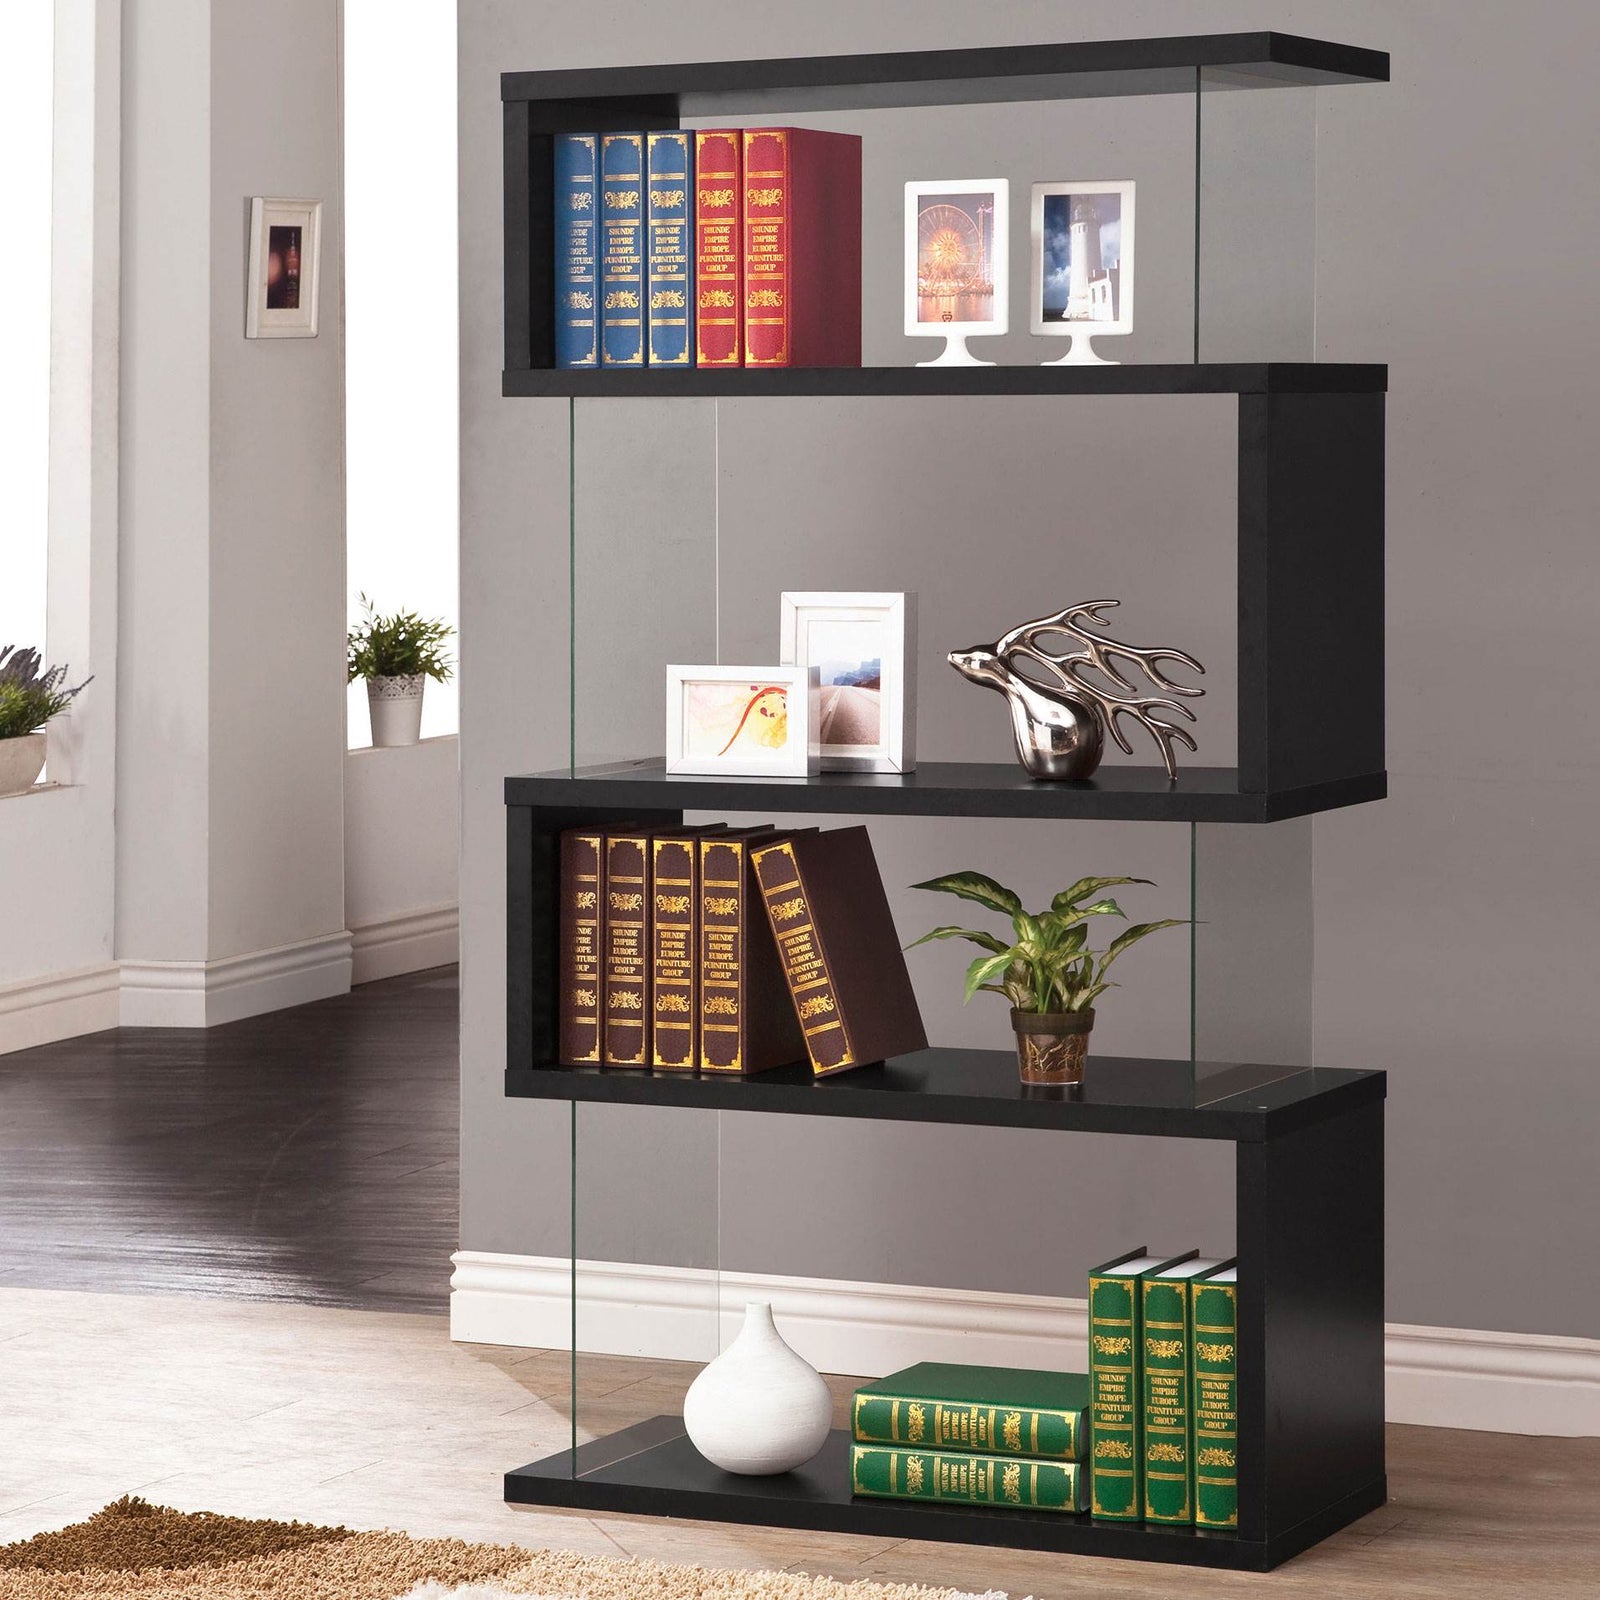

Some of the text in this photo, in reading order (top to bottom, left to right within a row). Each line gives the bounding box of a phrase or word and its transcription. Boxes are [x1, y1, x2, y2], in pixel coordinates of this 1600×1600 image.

[752, 225, 778, 233] SHUNDE
[650, 255, 685, 263] FURNITURE
[613, 929, 638, 937] SHUNDE
[660, 931, 686, 939] SHUNDE
[614, 938, 637, 946] EMPIRE
[784, 933, 810, 947] SHUNDE
[613, 947, 637, 955] EUROPE
[709, 943, 733, 951] EMPIRE
[787, 943, 812, 956] EMPIRE
[661, 950, 685, 958] EUROPE
[709, 952, 733, 960] EUROPE
[609, 956, 643, 965] FURNITURE
[790, 952, 815, 965] EUROPE
[656, 959, 690, 967] FURNITURE
[704, 962, 738, 970] FURNITURE
[615, 966, 635, 974] GROUP
[788, 959, 824, 976] FURNITURE
[710, 971, 731, 979] GROUP
[797, 971, 818, 982] GROUP
[1099, 1374, 1126, 1382] SHUNDE
[1151, 1377, 1179, 1386] SHUNDE
[1099, 1384, 1125, 1392] EMPIRE
[1201, 1381, 1229, 1390] SHUNDE
[1152, 1387, 1178, 1395] EMPIRE
[1099, 1394, 1126, 1402] EUROPE
[1202, 1391, 1228, 1400] EMPIRE
[1152, 1397, 1178, 1405] EUROPE
[1202, 1401, 1229, 1409] EUROPE
[1094, 1403, 1132, 1411] FURNITURE
[1147, 1406, 1185, 1415] FURNITURE
[1197, 1410, 1236, 1419] FURNITURE
[1153, 1417, 1176, 1425] GROUP
[1204, 1421, 1227, 1429] GROUP
[970, 1407, 978, 1447] FURNITURE
[969, 1459, 977, 1500] FURNITURE
